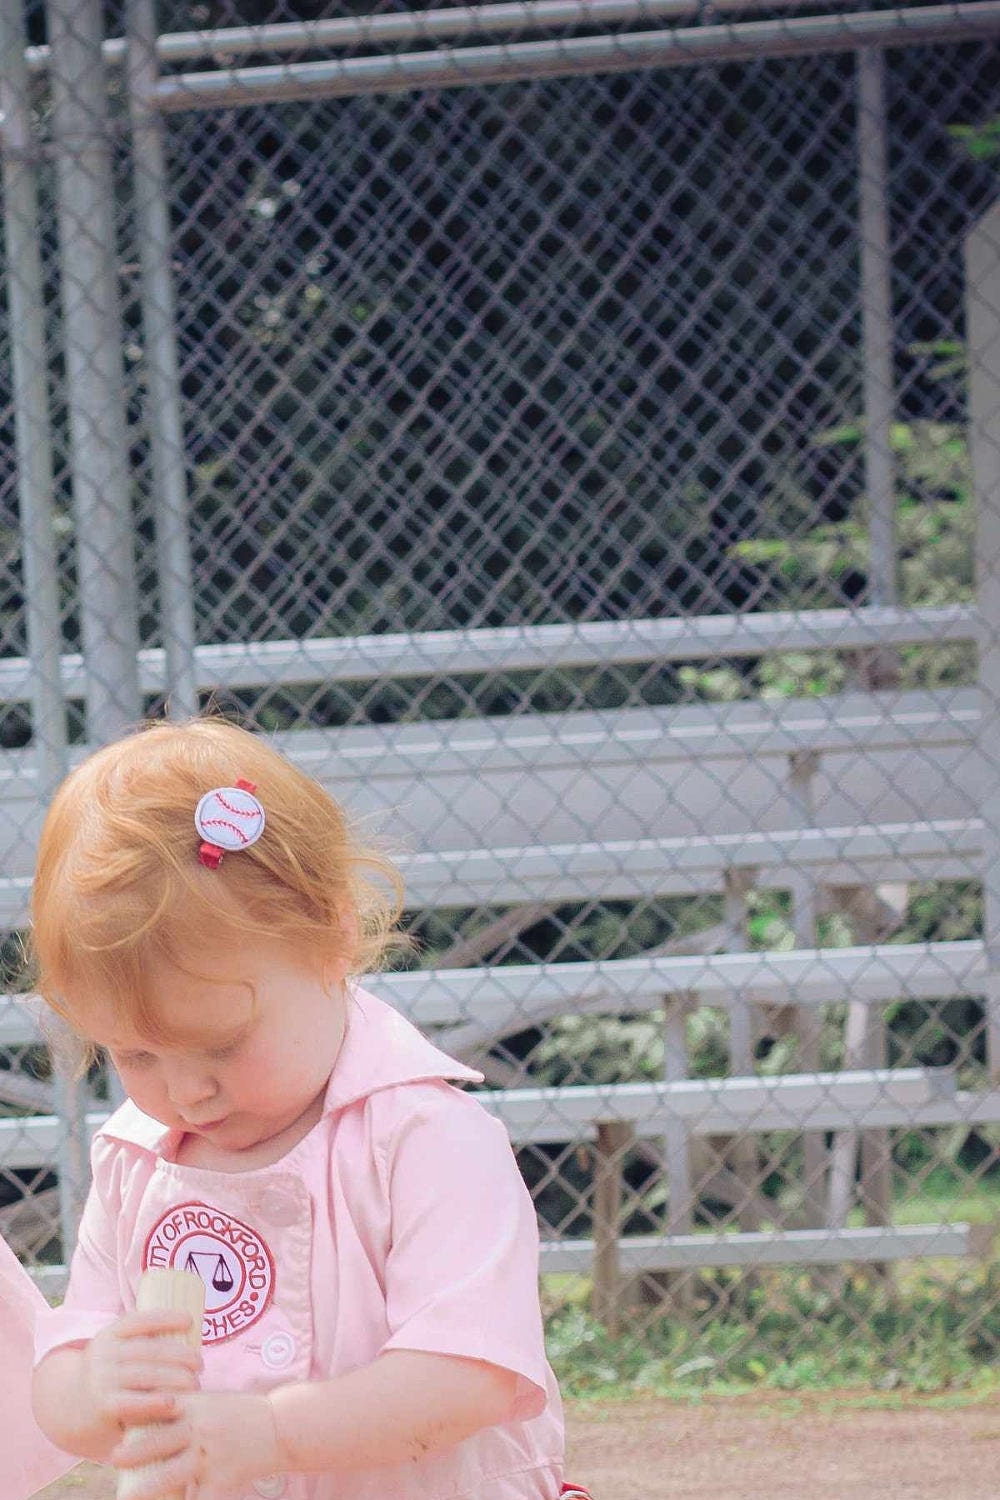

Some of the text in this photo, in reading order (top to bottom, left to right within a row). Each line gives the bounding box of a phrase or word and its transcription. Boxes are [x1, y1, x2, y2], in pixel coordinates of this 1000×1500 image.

[149, 1210, 267, 1290] ITY OF ROCKFORD
[201, 1300, 257, 1337] CHES
